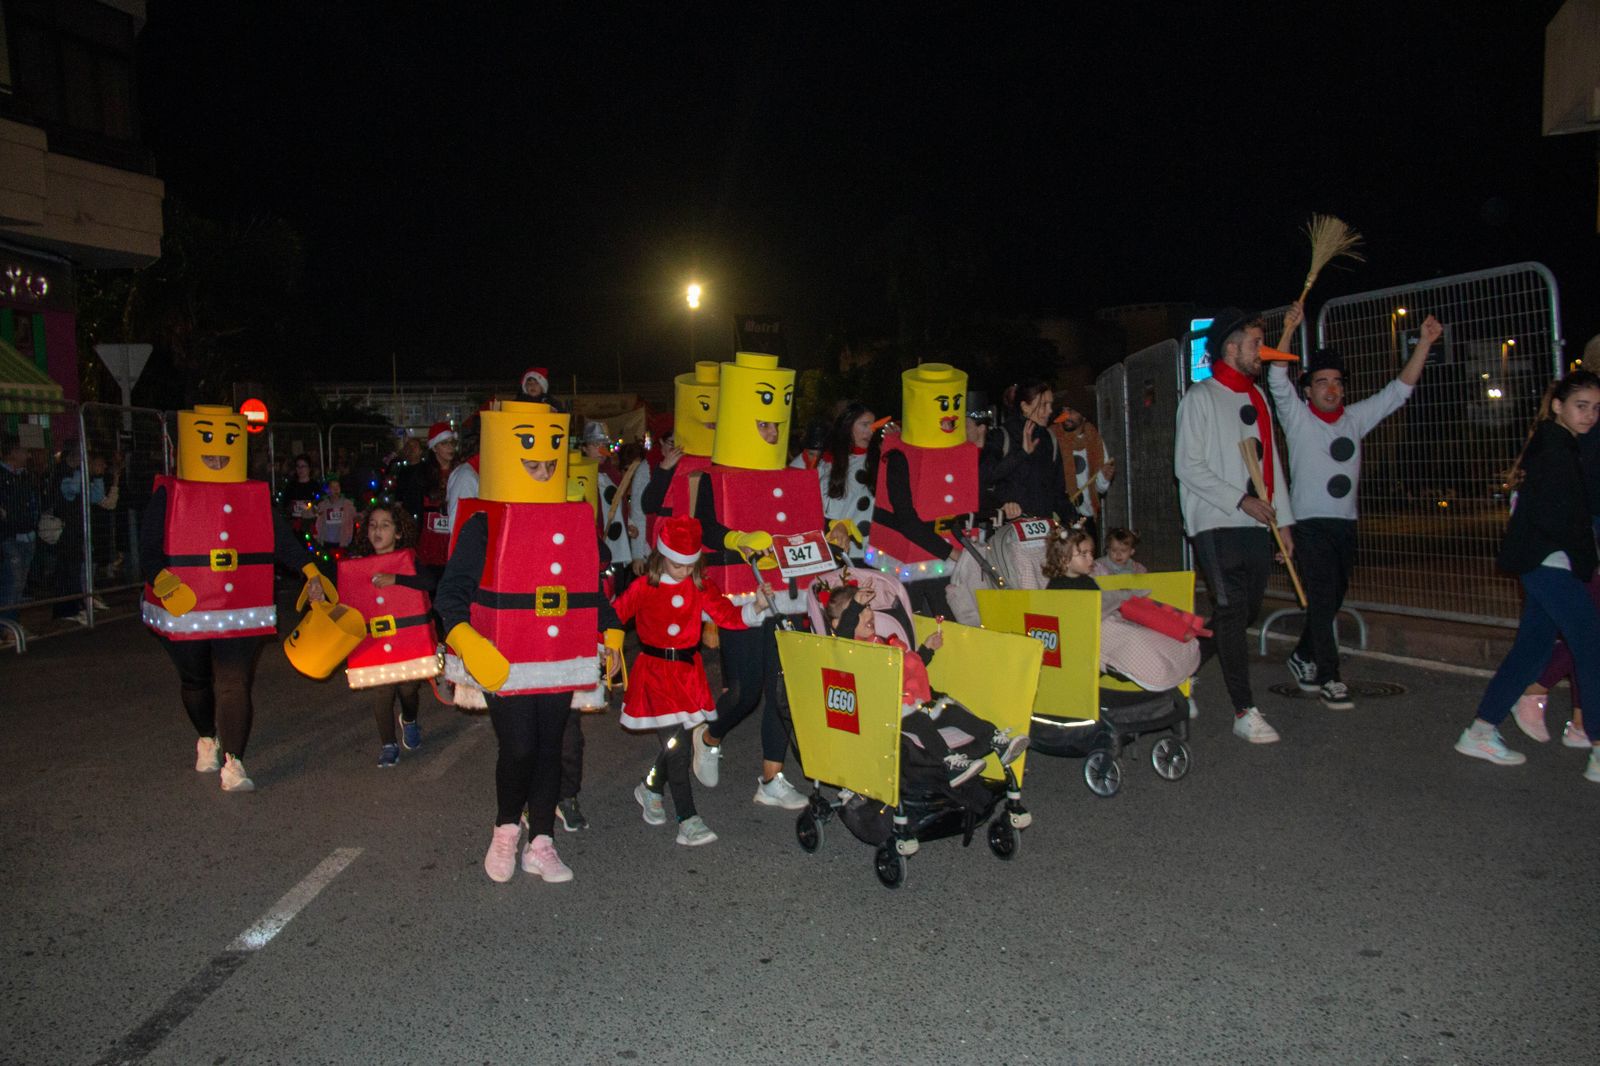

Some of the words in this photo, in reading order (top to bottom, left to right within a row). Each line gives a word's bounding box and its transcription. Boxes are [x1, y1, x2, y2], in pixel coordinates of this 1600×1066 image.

[1025, 522, 1046, 535] 339
[789, 545, 812, 561] 347
[827, 687, 856, 713] LEGO
